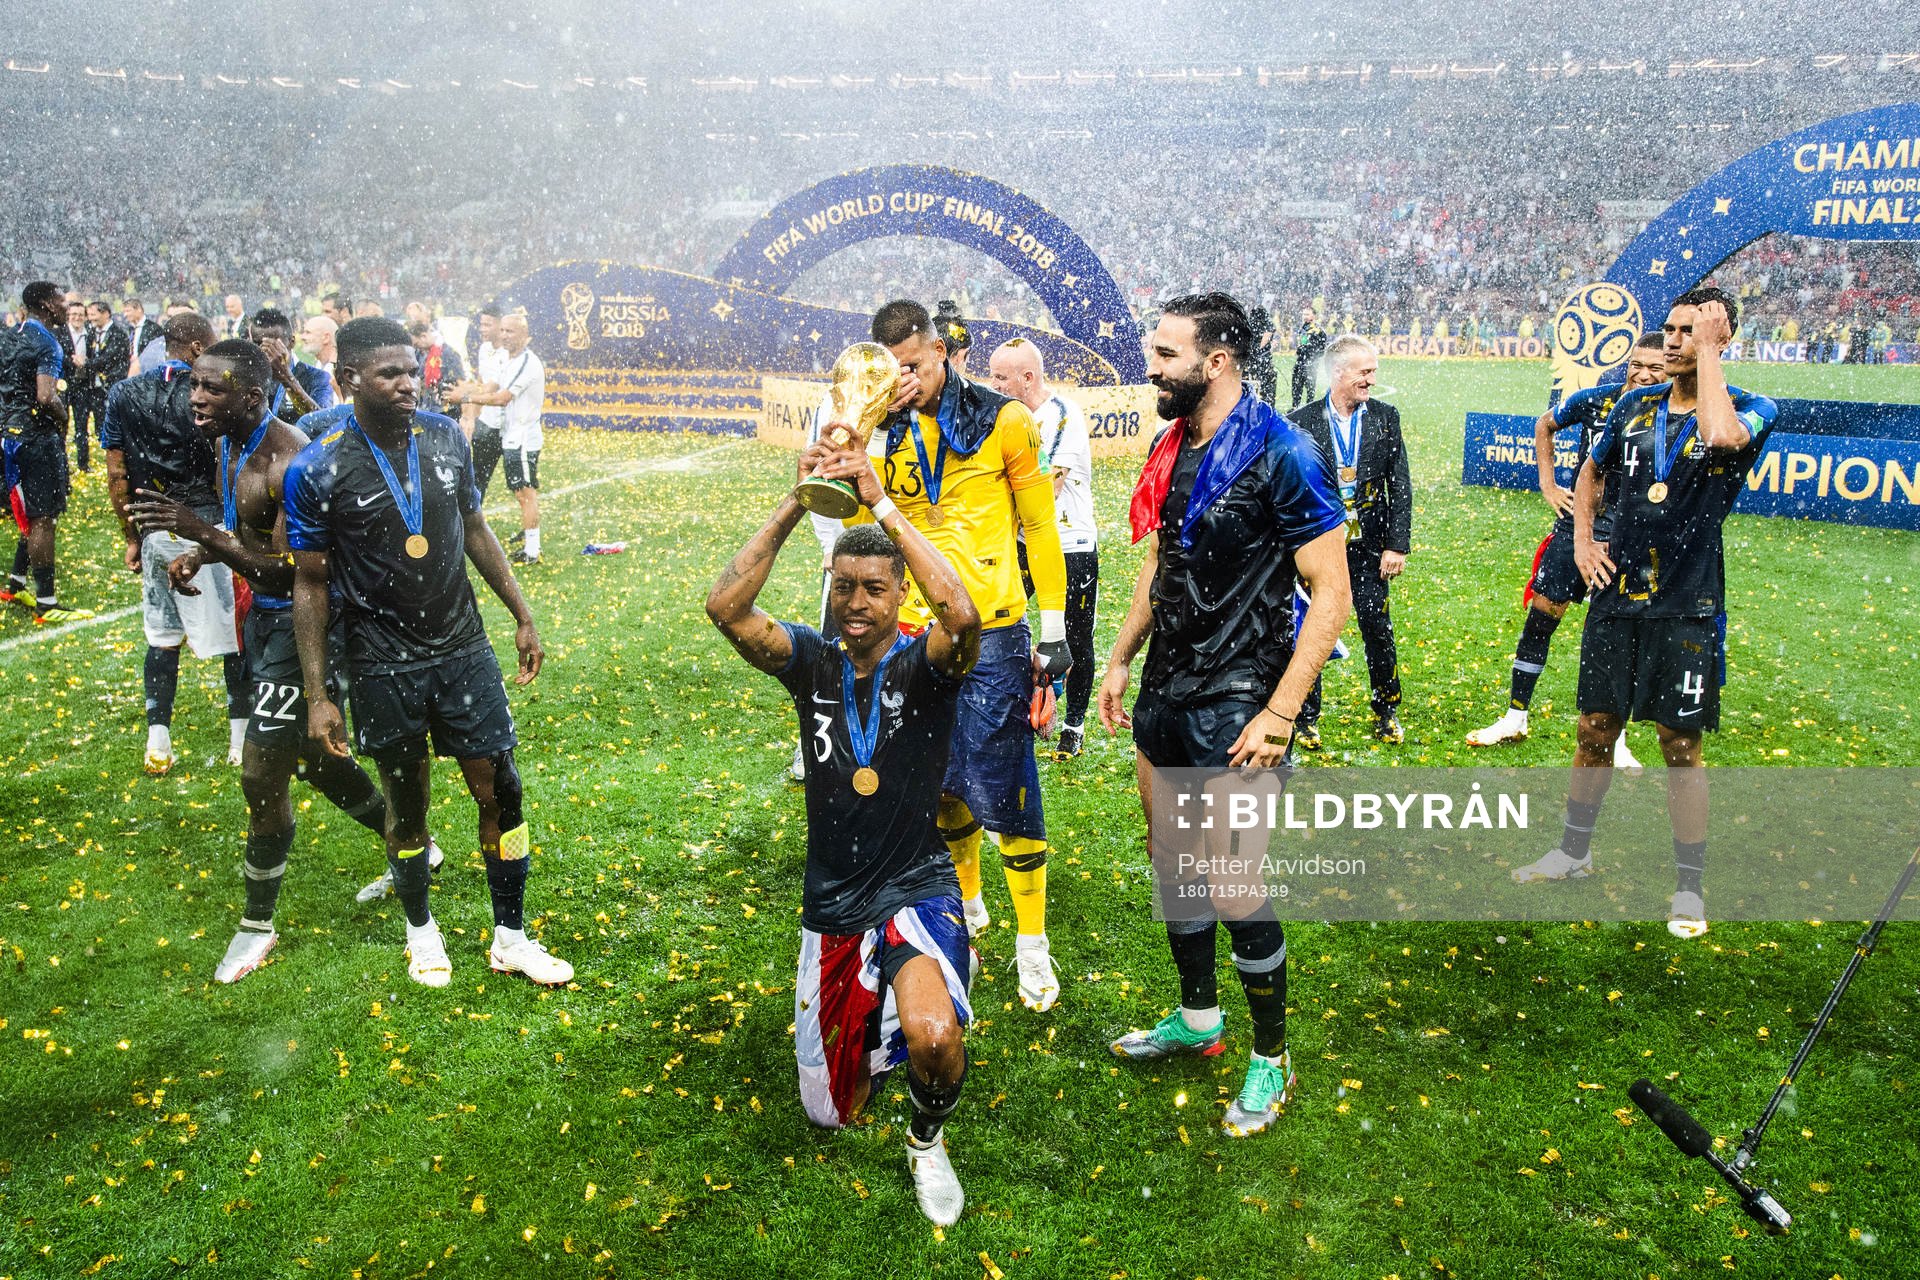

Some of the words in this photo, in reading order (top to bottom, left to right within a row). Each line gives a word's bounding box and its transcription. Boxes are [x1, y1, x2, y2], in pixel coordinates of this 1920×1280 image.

[1832, 179, 1868, 195] FIFA
[1812, 197, 1911, 226] FINAL
[763, 226, 807, 265] FIFA
[802, 194, 885, 235] WORLD
[943, 196, 1005, 237] FINAL
[1006, 225, 1056, 270] 2018
[599, 304, 671, 322] RUSSIA
[601, 321, 646, 338] 2018
[767, 402, 793, 430] FIFA
[1089, 411, 1140, 439] 2018
[1495, 434, 1514, 445] FIFA
[1486, 445, 1537, 466] FINAL
[1624, 441, 1640, 477] 4
[884, 458, 922, 497] 23
[254, 681, 300, 720] 22
[1682, 670, 1705, 705] 4
[813, 711, 833, 763] 3
